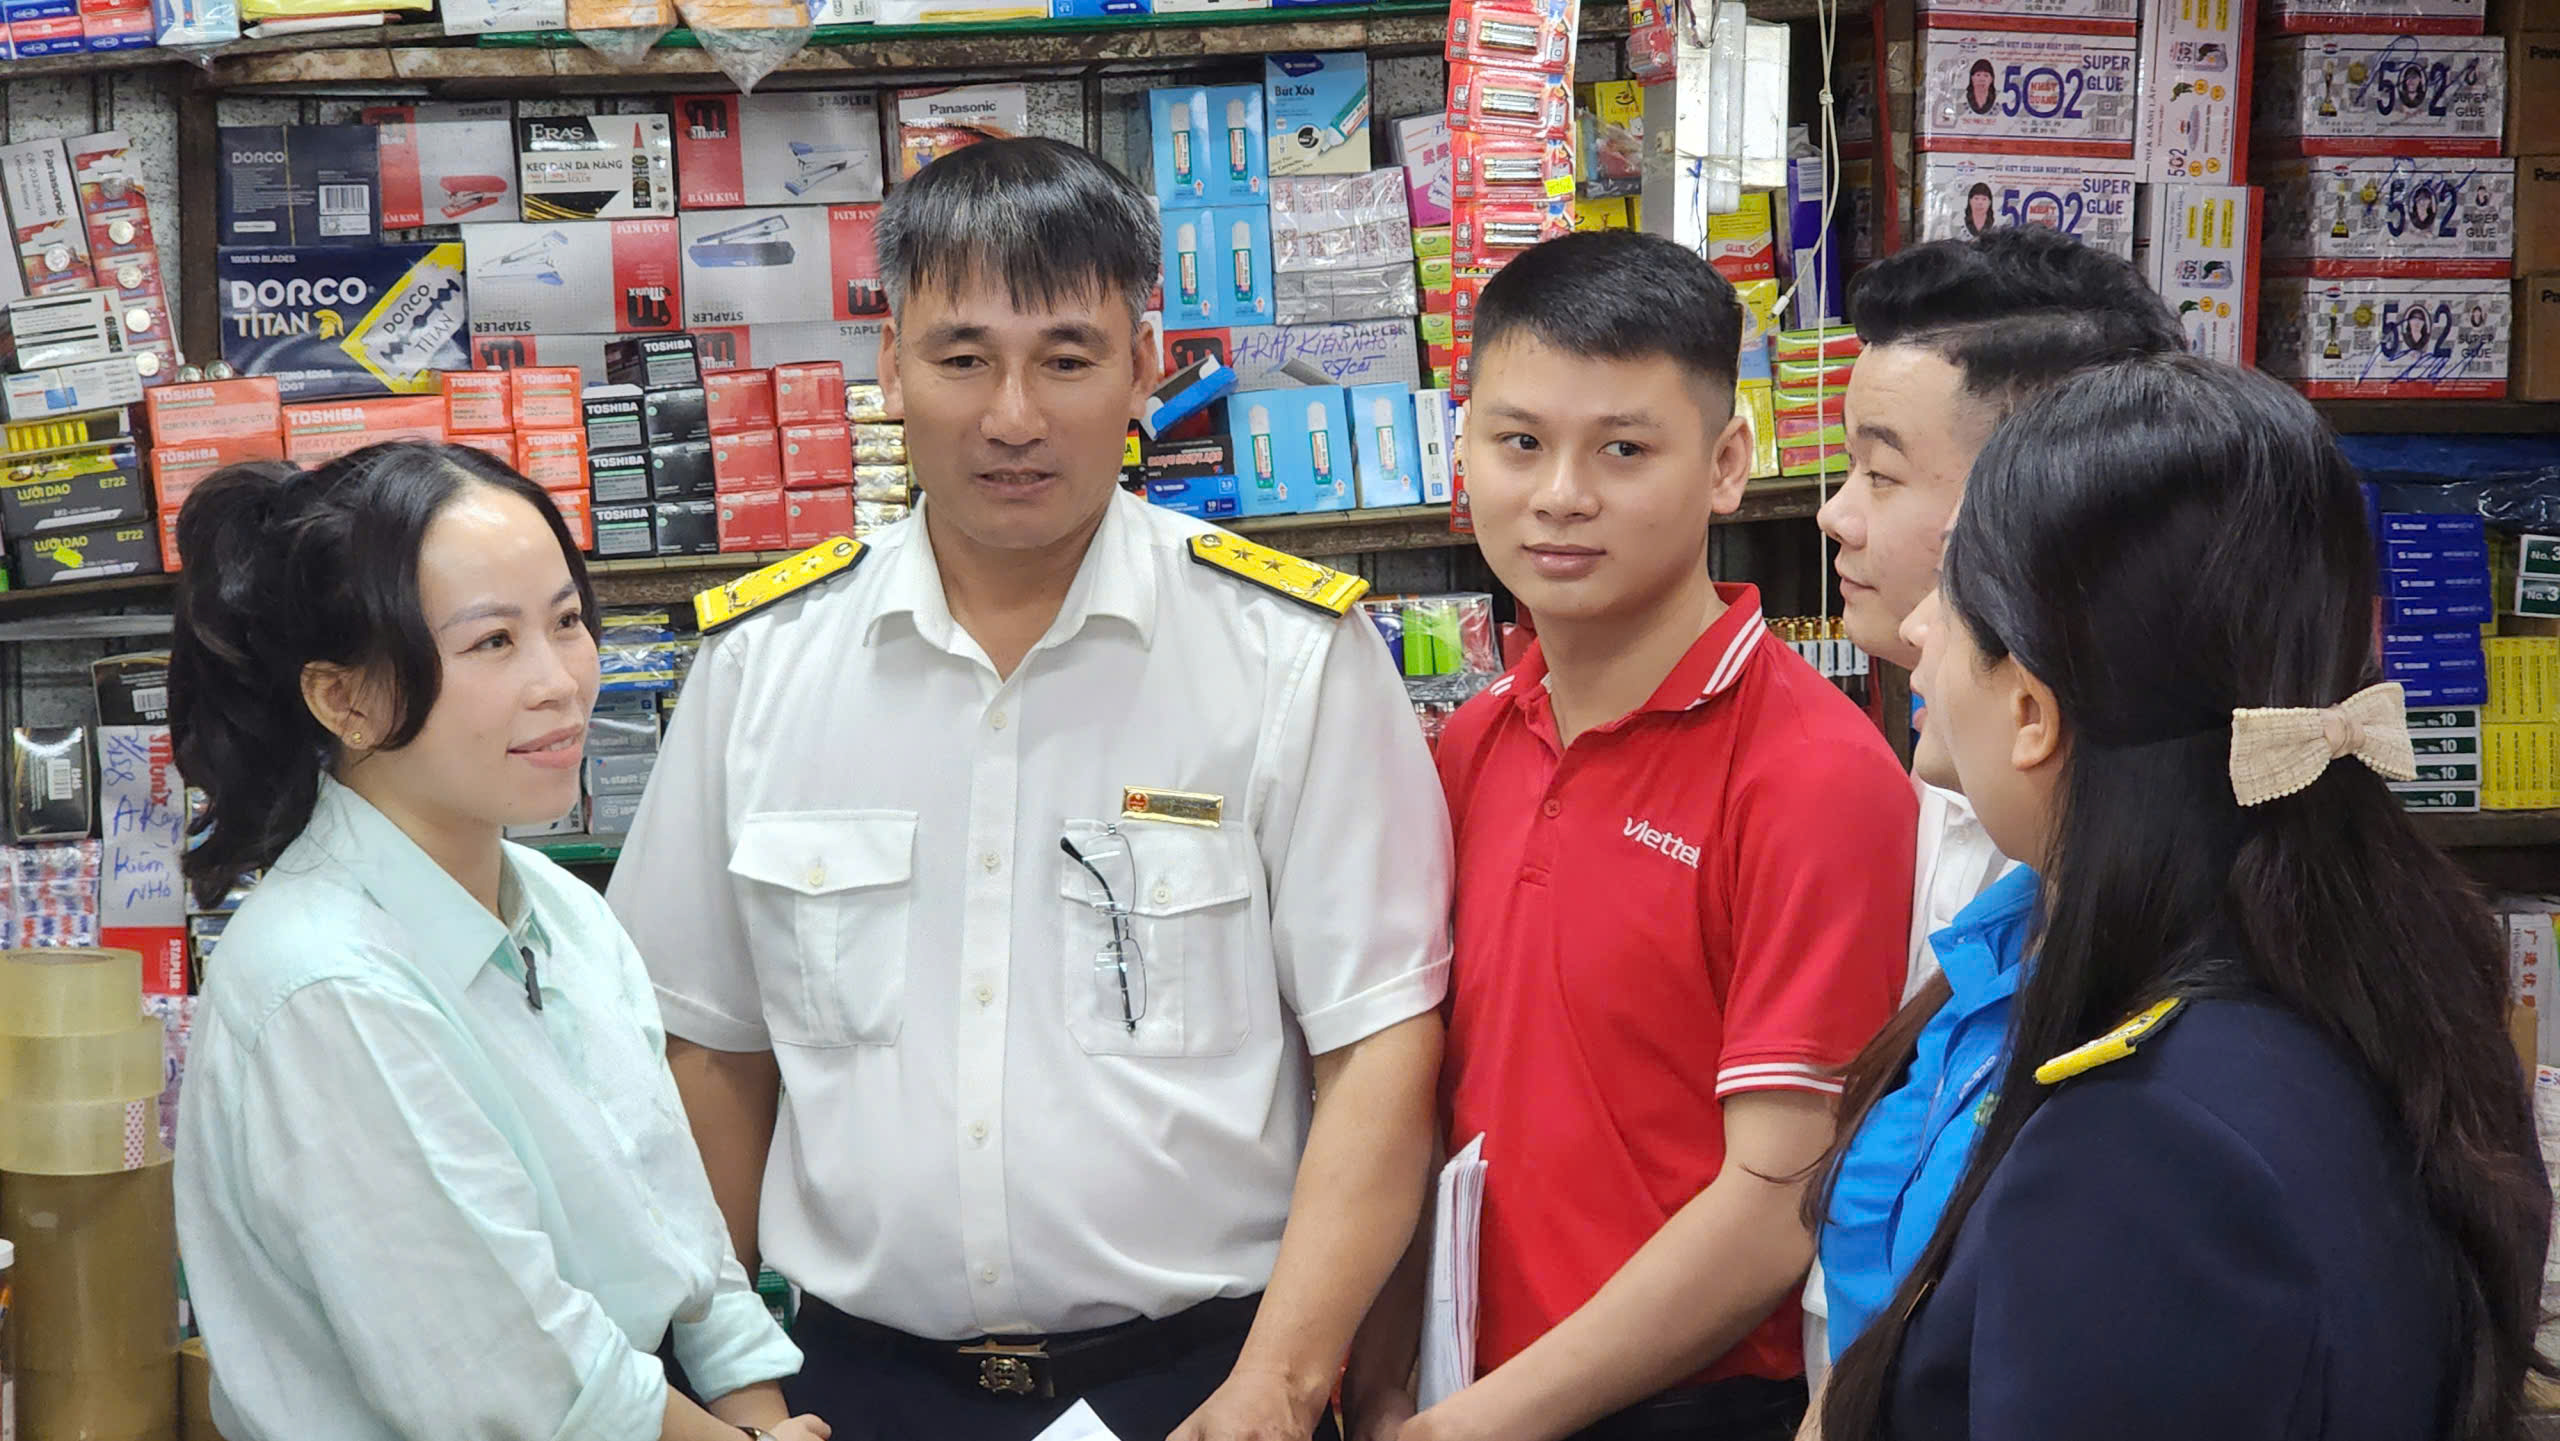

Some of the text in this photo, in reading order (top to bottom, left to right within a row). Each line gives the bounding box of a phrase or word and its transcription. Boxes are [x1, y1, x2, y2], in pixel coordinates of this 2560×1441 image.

[2083, 55, 2131, 71] SUPER
[2001, 65, 2084, 119] 502
[2086, 76, 2124, 92] GLUE
[2376, 60, 2448, 117] 502
[2453, 92, 2489, 104] SUPER
[929, 100, 997, 115] Panasonic
[2455, 107, 2486, 118] GLUE
[530, 123, 585, 141] ERAS
[232, 151, 285, 164] DORCO
[2167, 147, 2188, 176] 502
[43, 148, 66, 217] Panasonic
[2082, 178, 2131, 194] SUPER
[2000, 189, 2084, 239] 502
[2086, 199, 2124, 215] GLUE
[2386, 179, 2458, 238] 502
[2463, 212, 2499, 224] SUPER
[2466, 227, 2496, 238] GLUE
[2182, 258, 2198, 280] 502
[230, 277, 368, 309] DORCO
[382, 283, 431, 336] DORCO
[692, 311, 744, 323] STAPLER
[232, 307, 312, 340] TITAN
[474, 320, 532, 333] STAPLER
[2380, 303, 2452, 358] 502
[414, 312, 455, 354] TITAN
[2458, 333, 2495, 345] SUPER
[643, 339, 693, 353] TOSHIBA
[155, 386, 216, 402] TOSHIBA
[288, 407, 366, 425] TOSHIBA
[585, 401, 639, 415] TOSHIBA
[158, 447, 220, 463] TOSHIBA
[592, 454, 646, 468] TOSHIBA
[46, 483, 71, 497] DAO
[99, 476, 127, 488] E722
[596, 508, 649, 521] TOSHIBA
[116, 529, 144, 542] E722
[2547, 586, 2559, 602] 3
[2440, 712, 2457, 726] 10
[2440, 739, 2457, 752] 10
[2440, 766, 2457, 780] 10
[2440, 792, 2457, 805] 10
[1623, 816, 1702, 870] viettel
[168, 938, 181, 990] STAPLER
